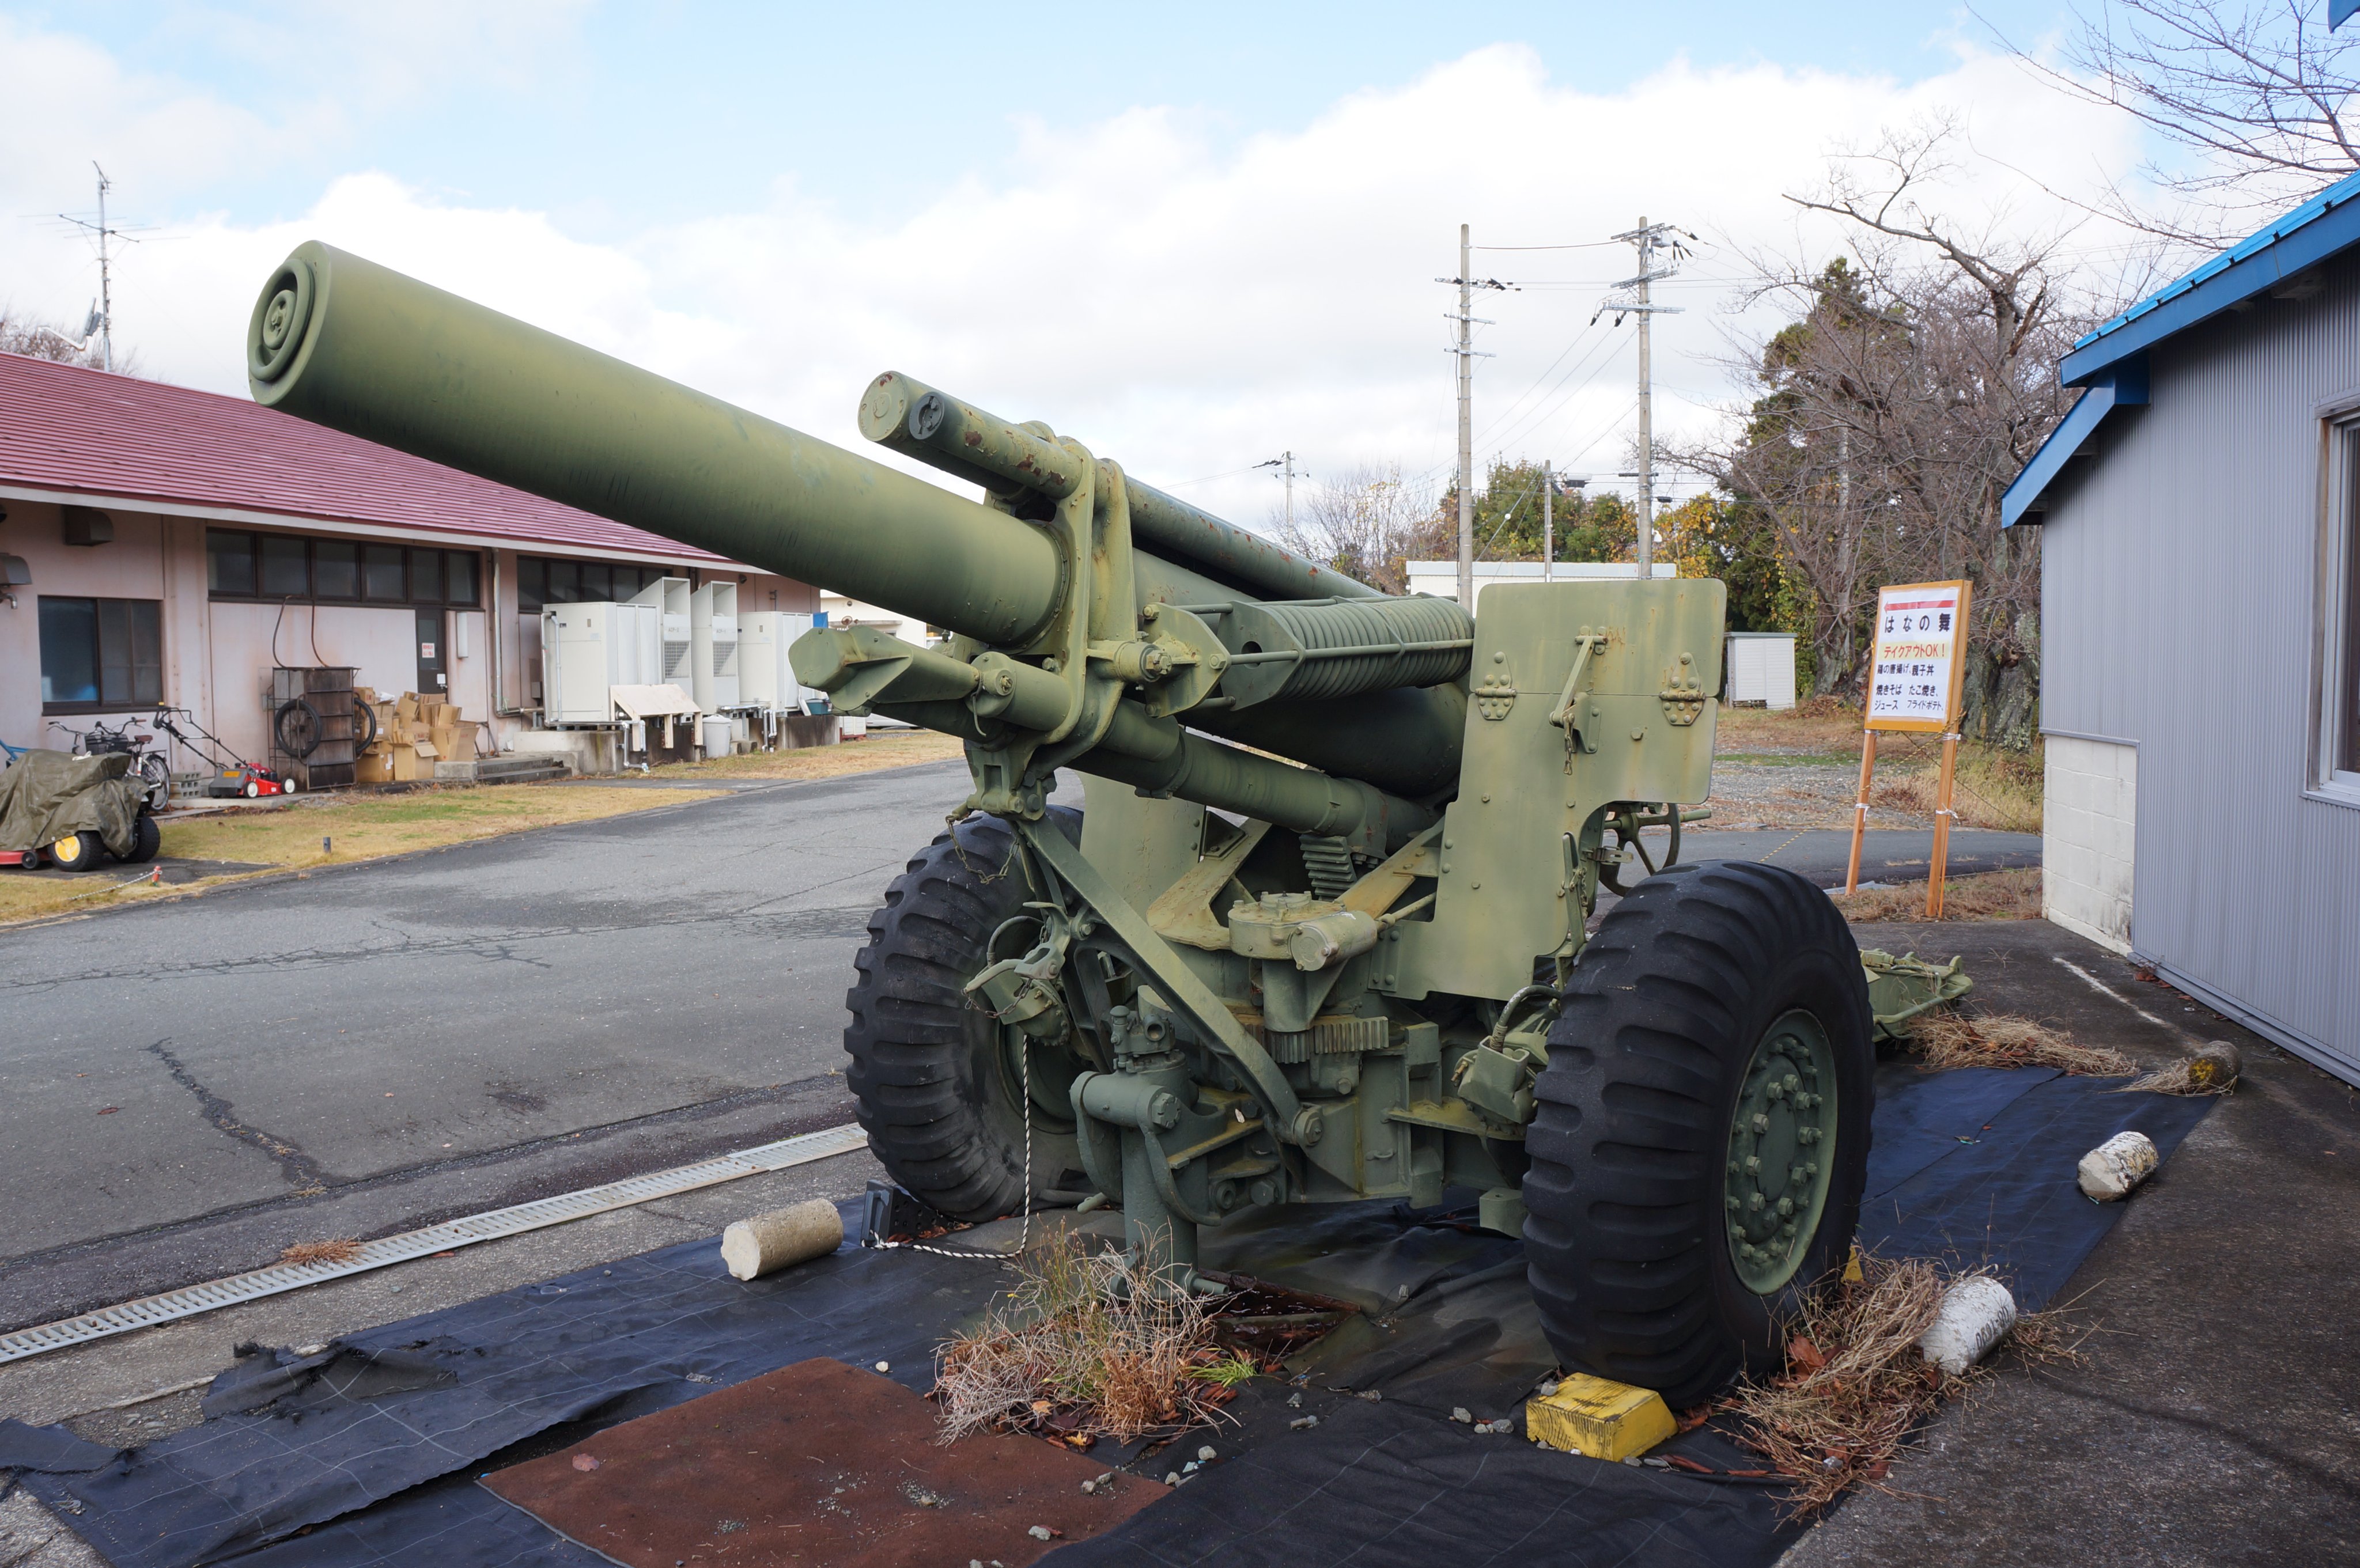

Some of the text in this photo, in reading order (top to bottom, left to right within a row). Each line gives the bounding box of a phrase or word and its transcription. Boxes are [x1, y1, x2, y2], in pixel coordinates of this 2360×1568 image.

[1884, 613, 1951, 633] はなの舞
[1876, 684, 1903, 695] 焼きそば
[1874, 700, 1898, 711] ジュース
